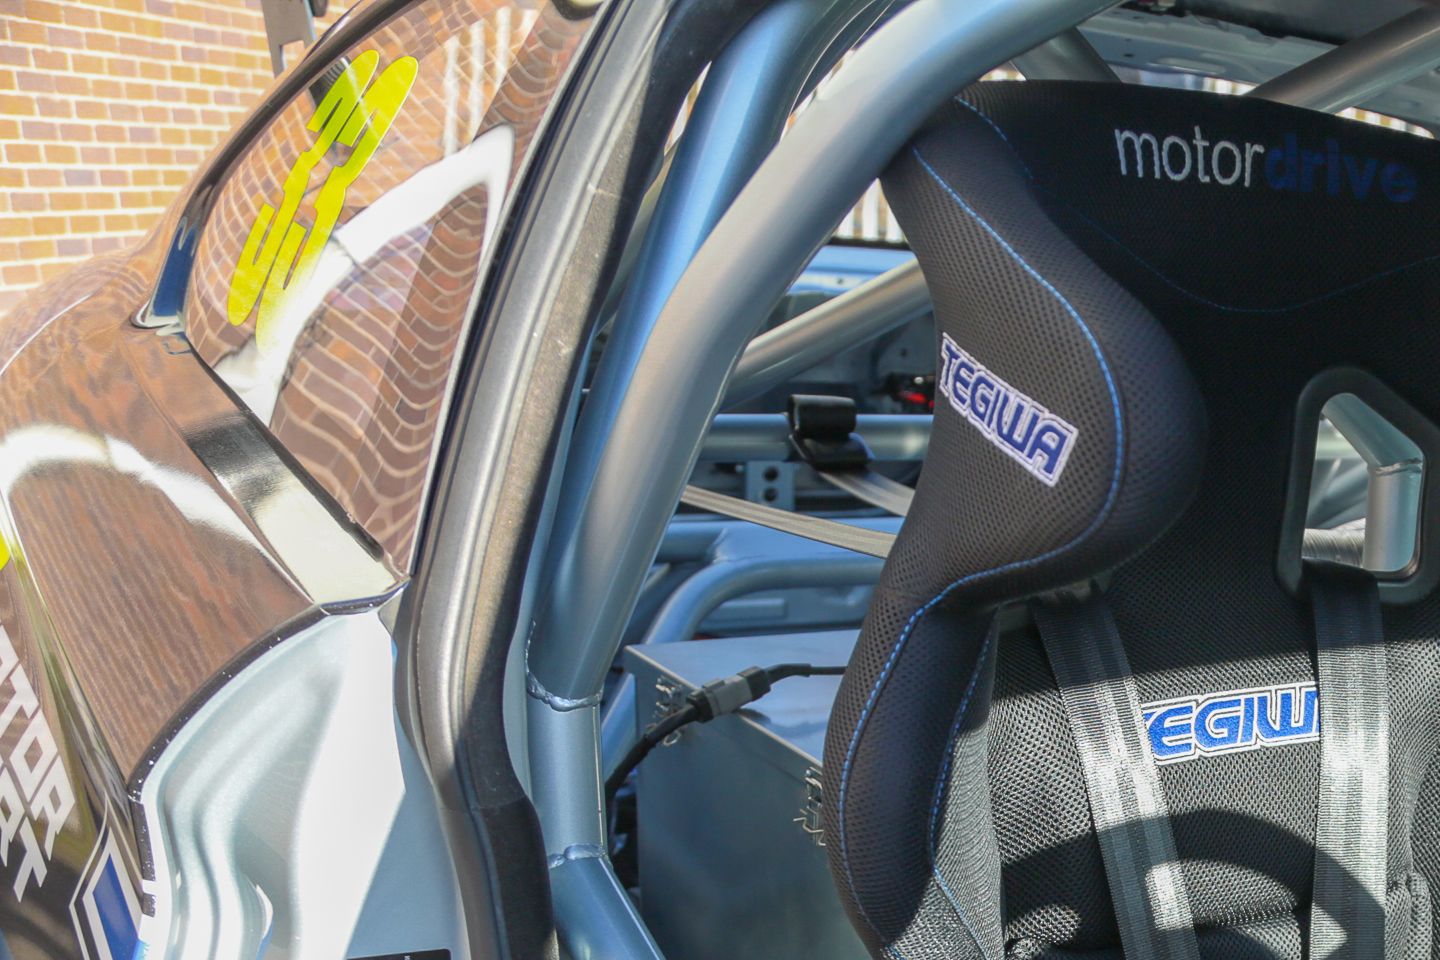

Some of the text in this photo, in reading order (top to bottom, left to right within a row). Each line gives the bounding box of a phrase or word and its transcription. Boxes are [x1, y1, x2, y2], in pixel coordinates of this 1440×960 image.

[227, 50, 419, 348] 33
[1114, 125, 1418, 203] motordrive
[941, 336, 1076, 482] TEGIWA
[1143, 685, 1319, 760] EGIW
